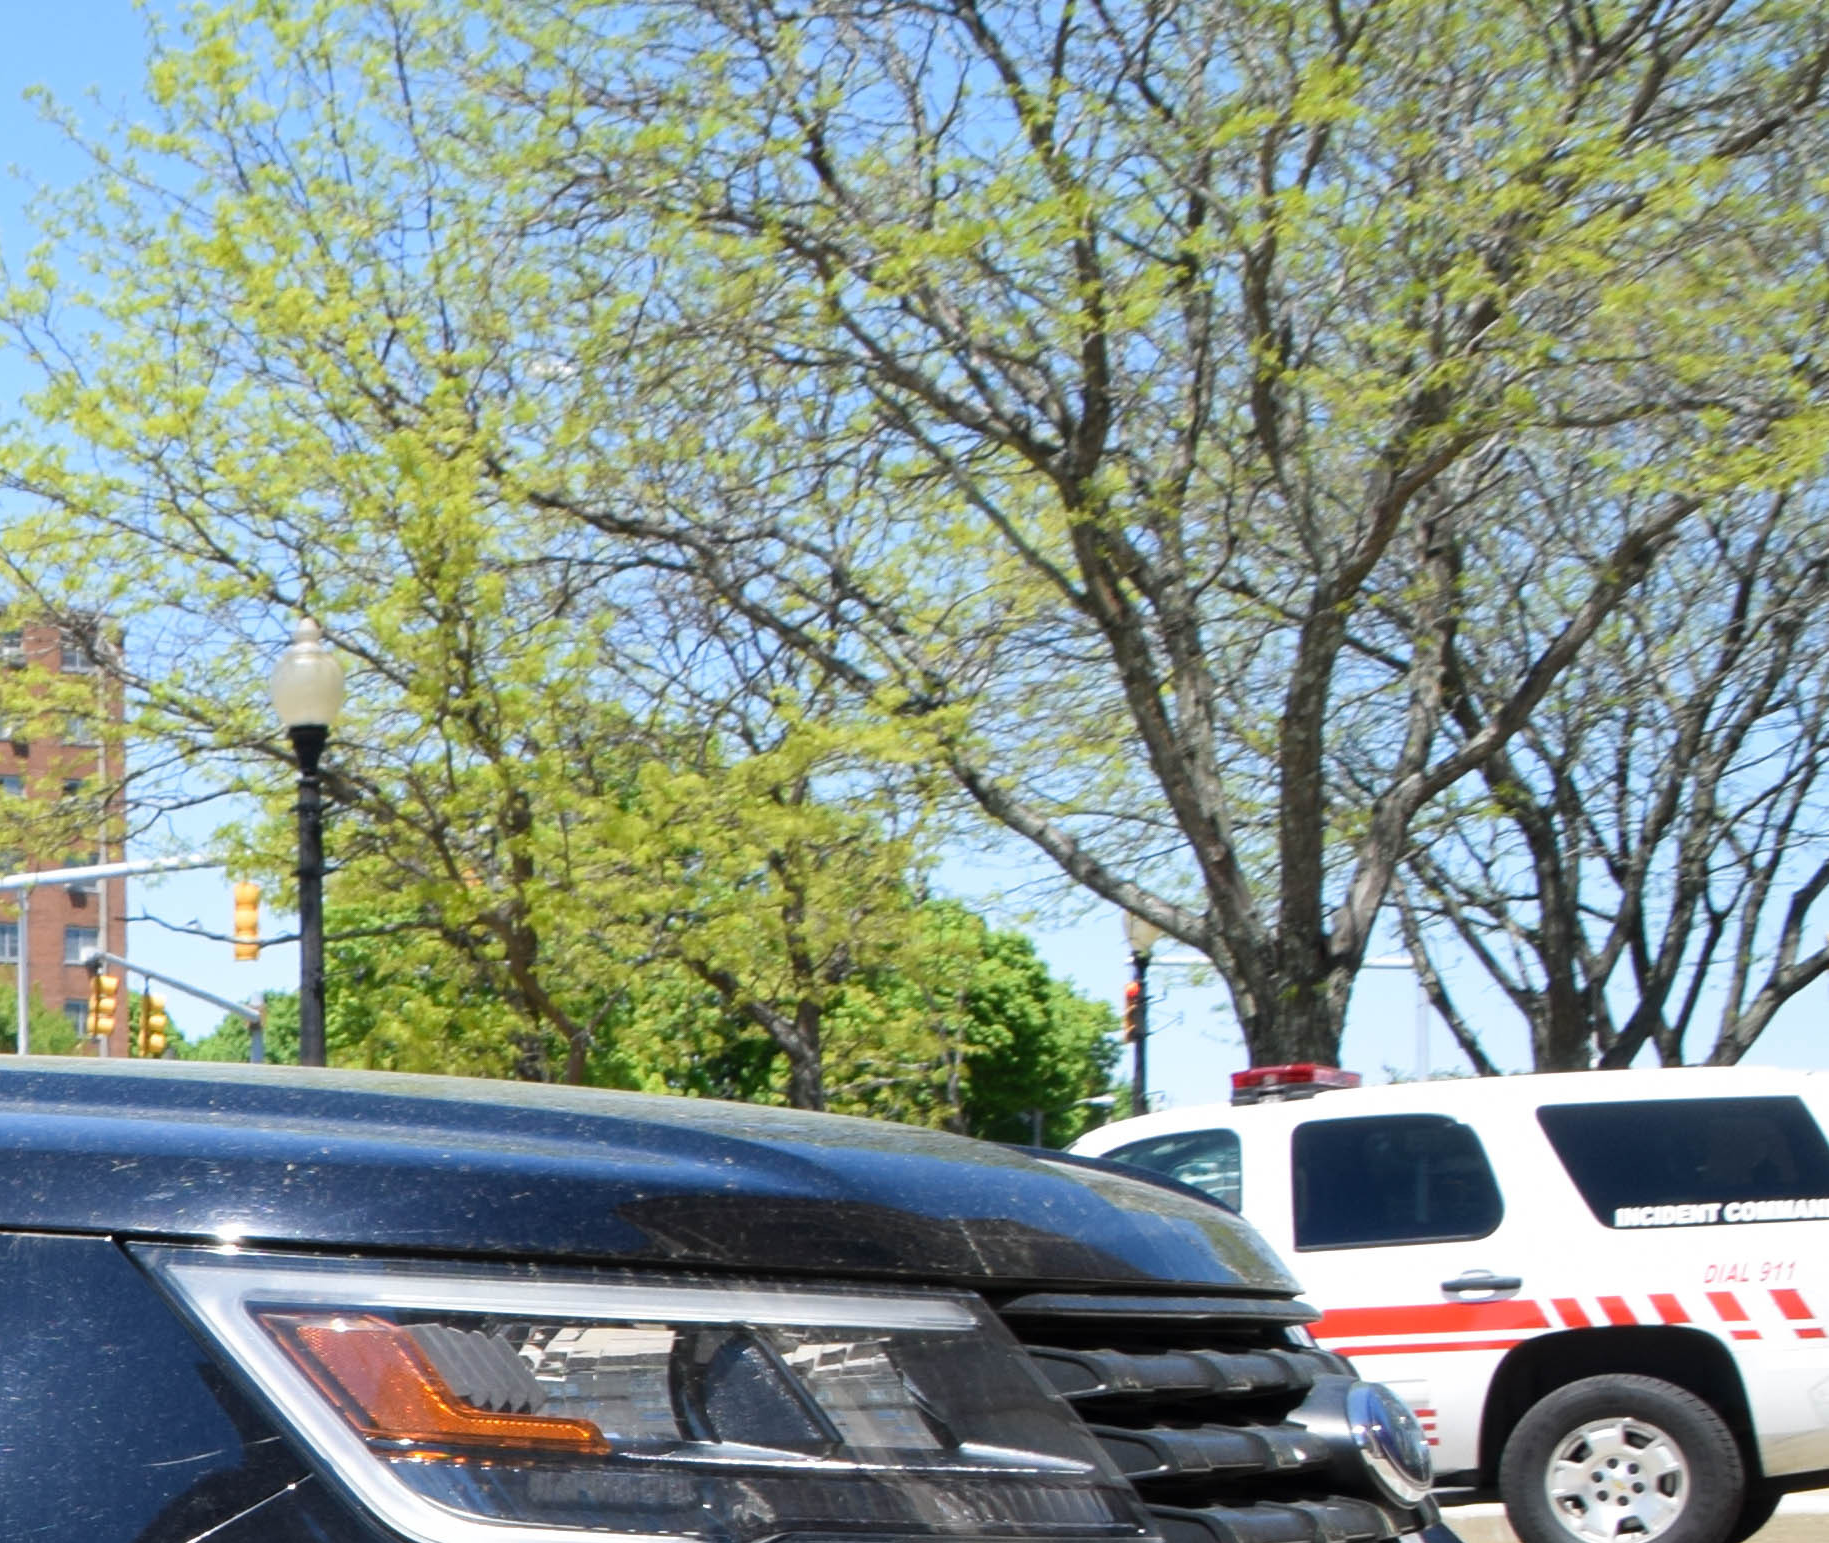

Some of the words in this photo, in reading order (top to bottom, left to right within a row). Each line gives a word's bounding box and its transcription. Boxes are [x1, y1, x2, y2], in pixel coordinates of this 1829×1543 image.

[1615, 1203, 1721, 1227] INCIDENT
[1704, 1263, 1749, 1284] DIAL
[1759, 1260, 1797, 1282] 911
